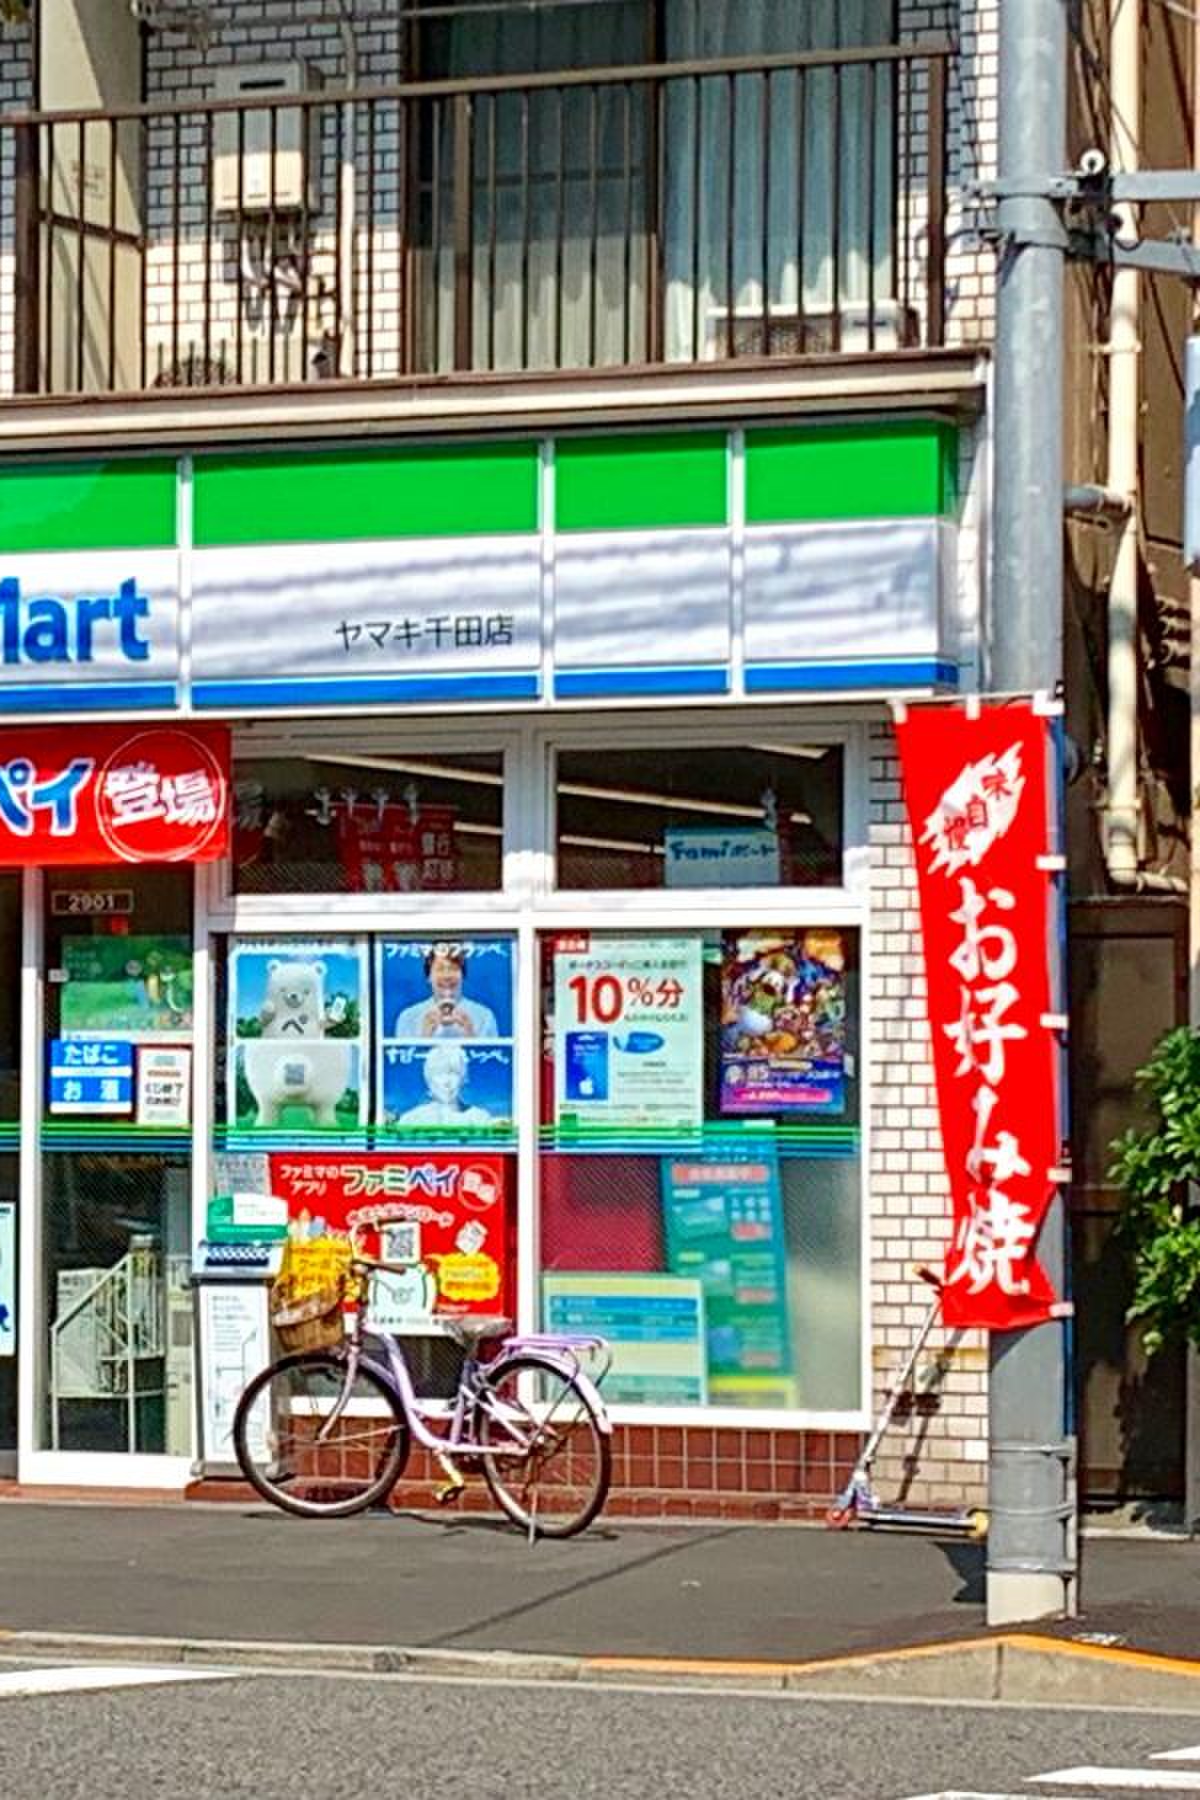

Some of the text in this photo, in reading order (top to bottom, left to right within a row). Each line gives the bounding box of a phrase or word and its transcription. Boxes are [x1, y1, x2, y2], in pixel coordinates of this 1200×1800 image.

[335, 614, 515, 651] ヤマキ千田店
[104, 761, 215, 827] 登場
[68, 895, 115, 912] 2901
[63, 1044, 119, 1064] たばこ
[289, 1180, 328, 1195] アプリ
[340, 1164, 459, 1197] ファミペイ
